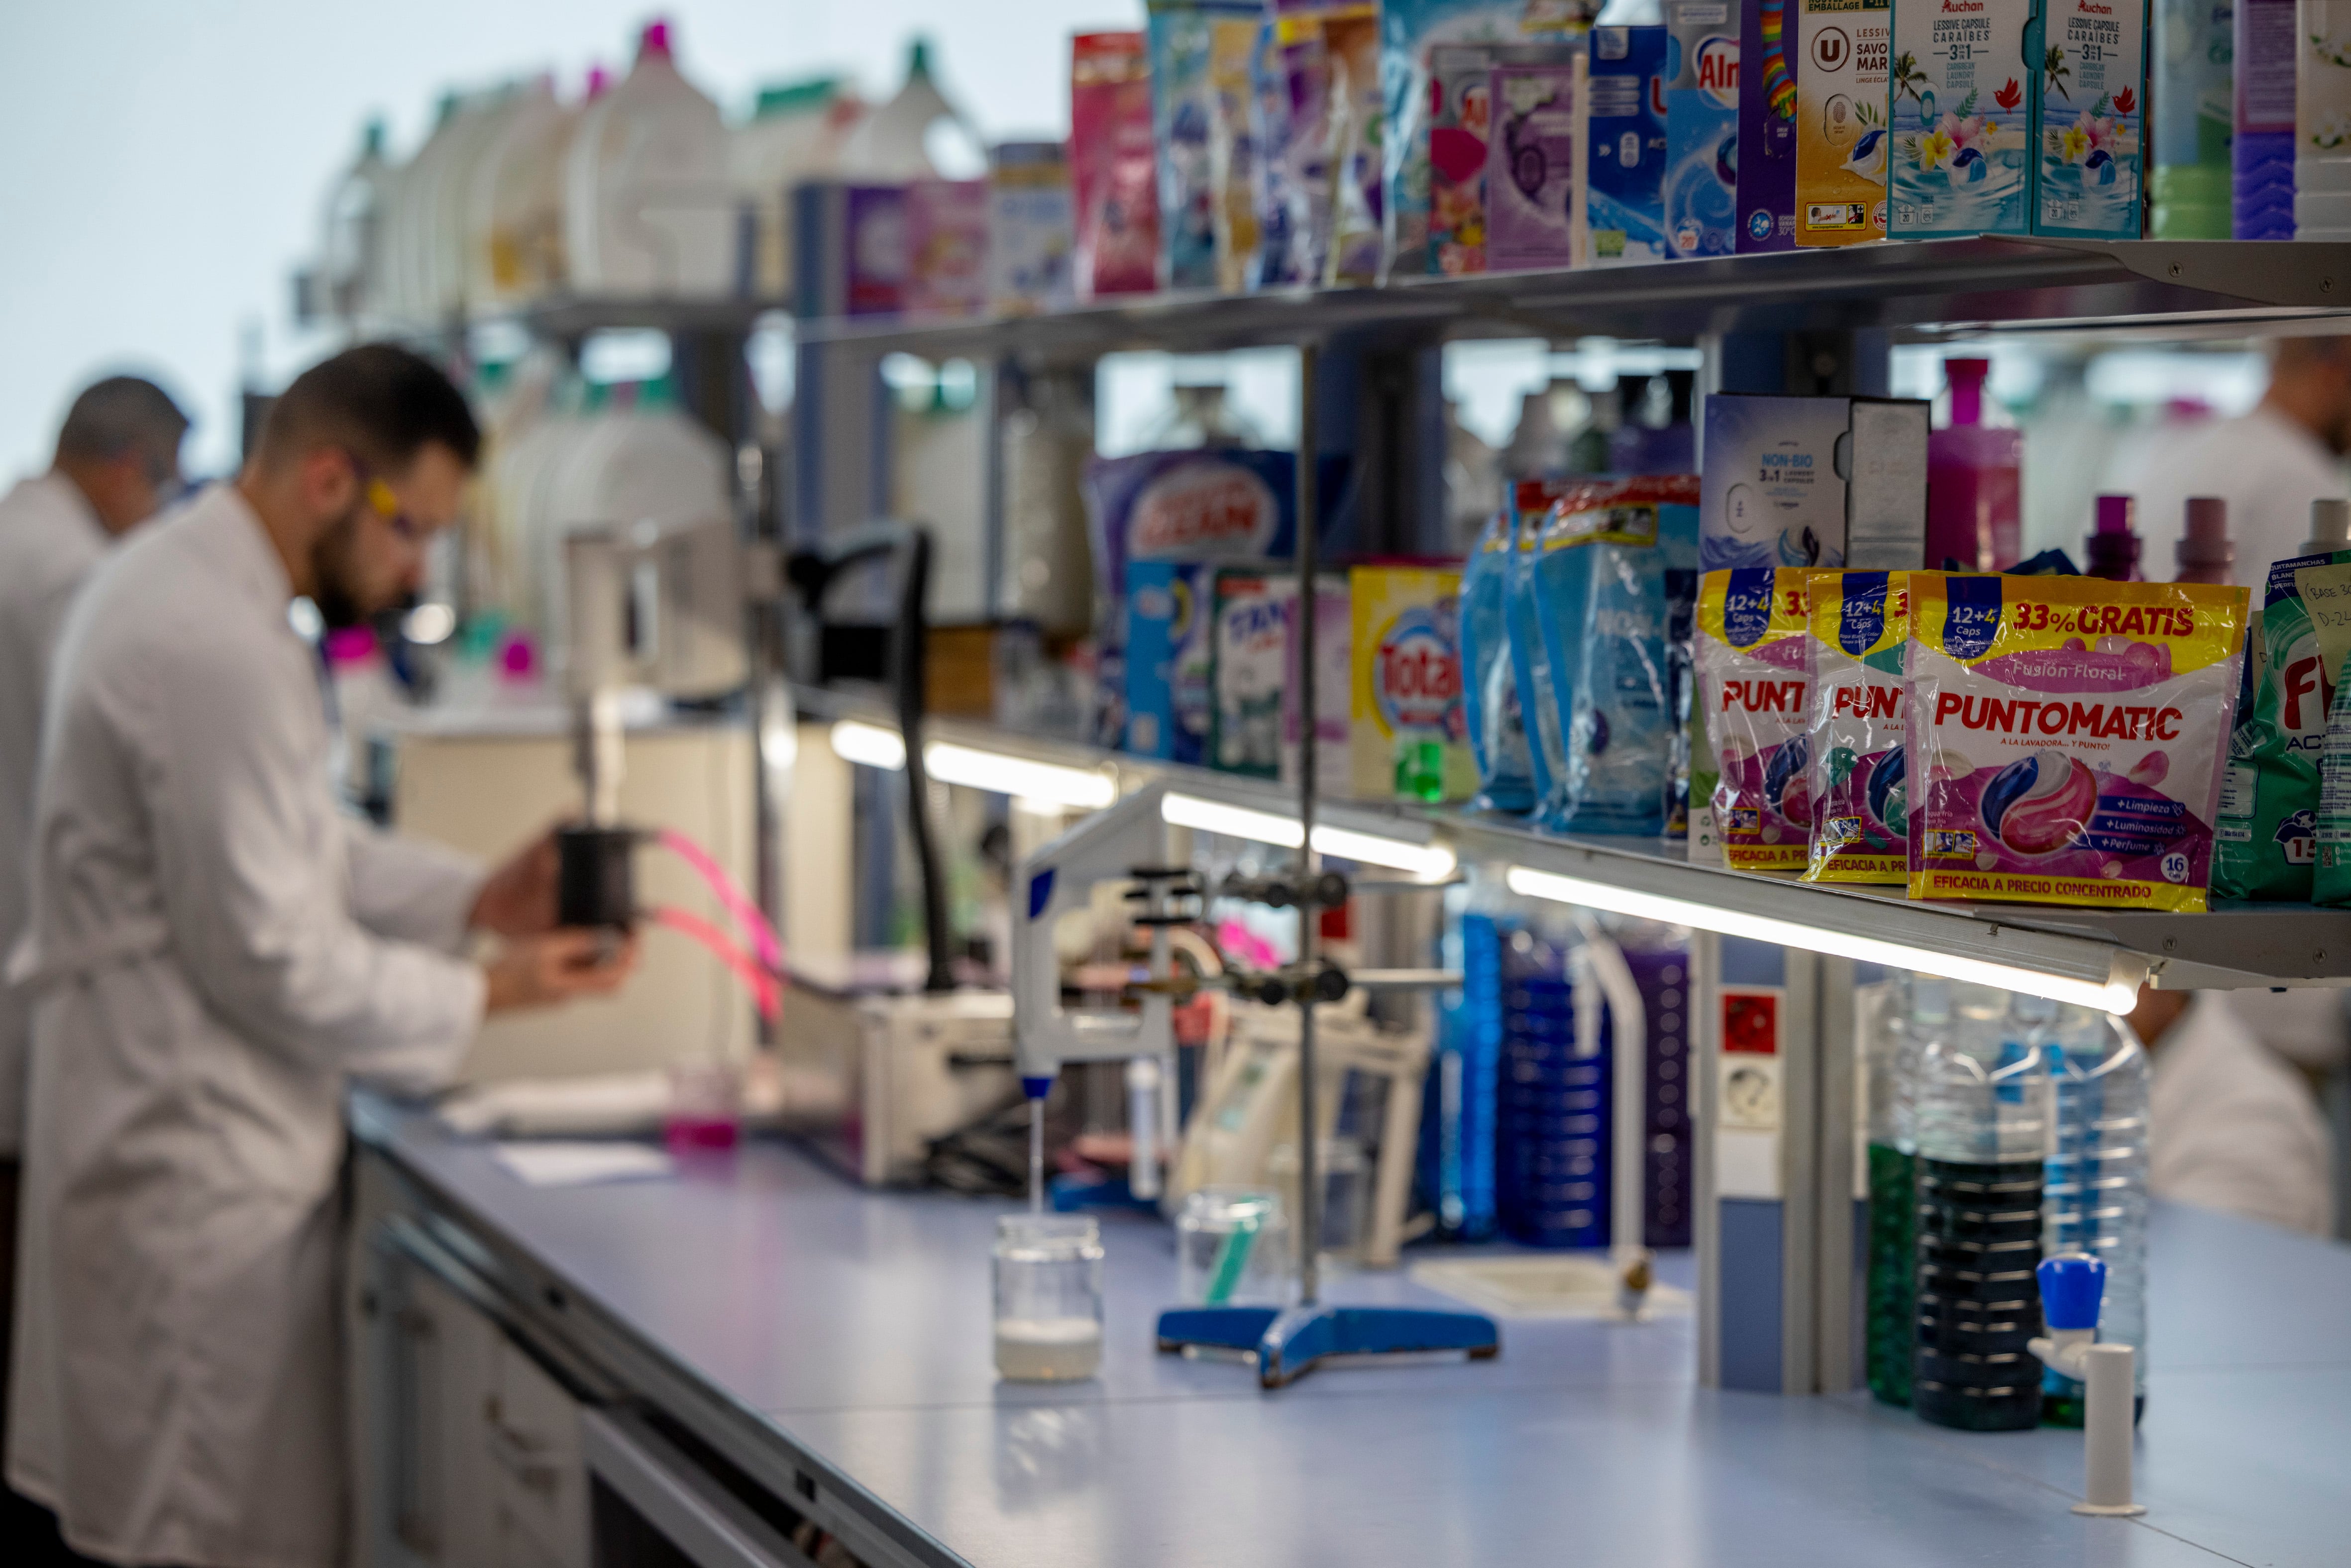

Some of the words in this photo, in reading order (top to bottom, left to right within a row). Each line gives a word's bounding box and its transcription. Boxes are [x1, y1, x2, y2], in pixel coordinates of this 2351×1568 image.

[1809, 2, 1860, 11] EMBALLAGE
[1942, 0, 1984, 13] Auchan
[2078, 0, 2112, 15] Auchan
[1933, 19, 1960, 31] LESSIVE
[1961, 17, 1990, 30] CAPSULE
[2068, 17, 2092, 30] LESSIVE
[2093, 19, 2120, 32] CAPSULE
[1933, 30, 1990, 43] CARAÏBES
[1820, 40, 1840, 62] U
[1856, 43, 1890, 55] SAVO
[1950, 44, 1958, 60] 3
[1966, 44, 1971, 60] 1
[2082, 44, 2090, 60] 3
[2096, 45, 2102, 61] 1
[1856, 57, 1888, 71] MAR
[1761, 453, 1814, 468] NON-BIO
[1759, 469, 1767, 482] 3
[1844, 599, 1881, 617] 12+4
[1952, 606, 1996, 624] 12+4
[1956, 626, 1981, 637] Caps
[2013, 660, 2068, 678] Fusión
[2074, 664, 2124, 681] Floral
[1934, 692, 2183, 741] PUNTOMATIC
[2078, 741, 2111, 751] PUNTO!
[1780, 850, 1789, 862] A
[1827, 859, 1877, 872] EFICACIA
[1879, 860, 1888, 872] A
[2166, 856, 2184, 872] 16
[1933, 875, 1990, 890] EFICACIA
[1993, 877, 2004, 891] A
[2007, 879, 2051, 894] PRECIO
[2055, 881, 2151, 899] CONCENTRADO
